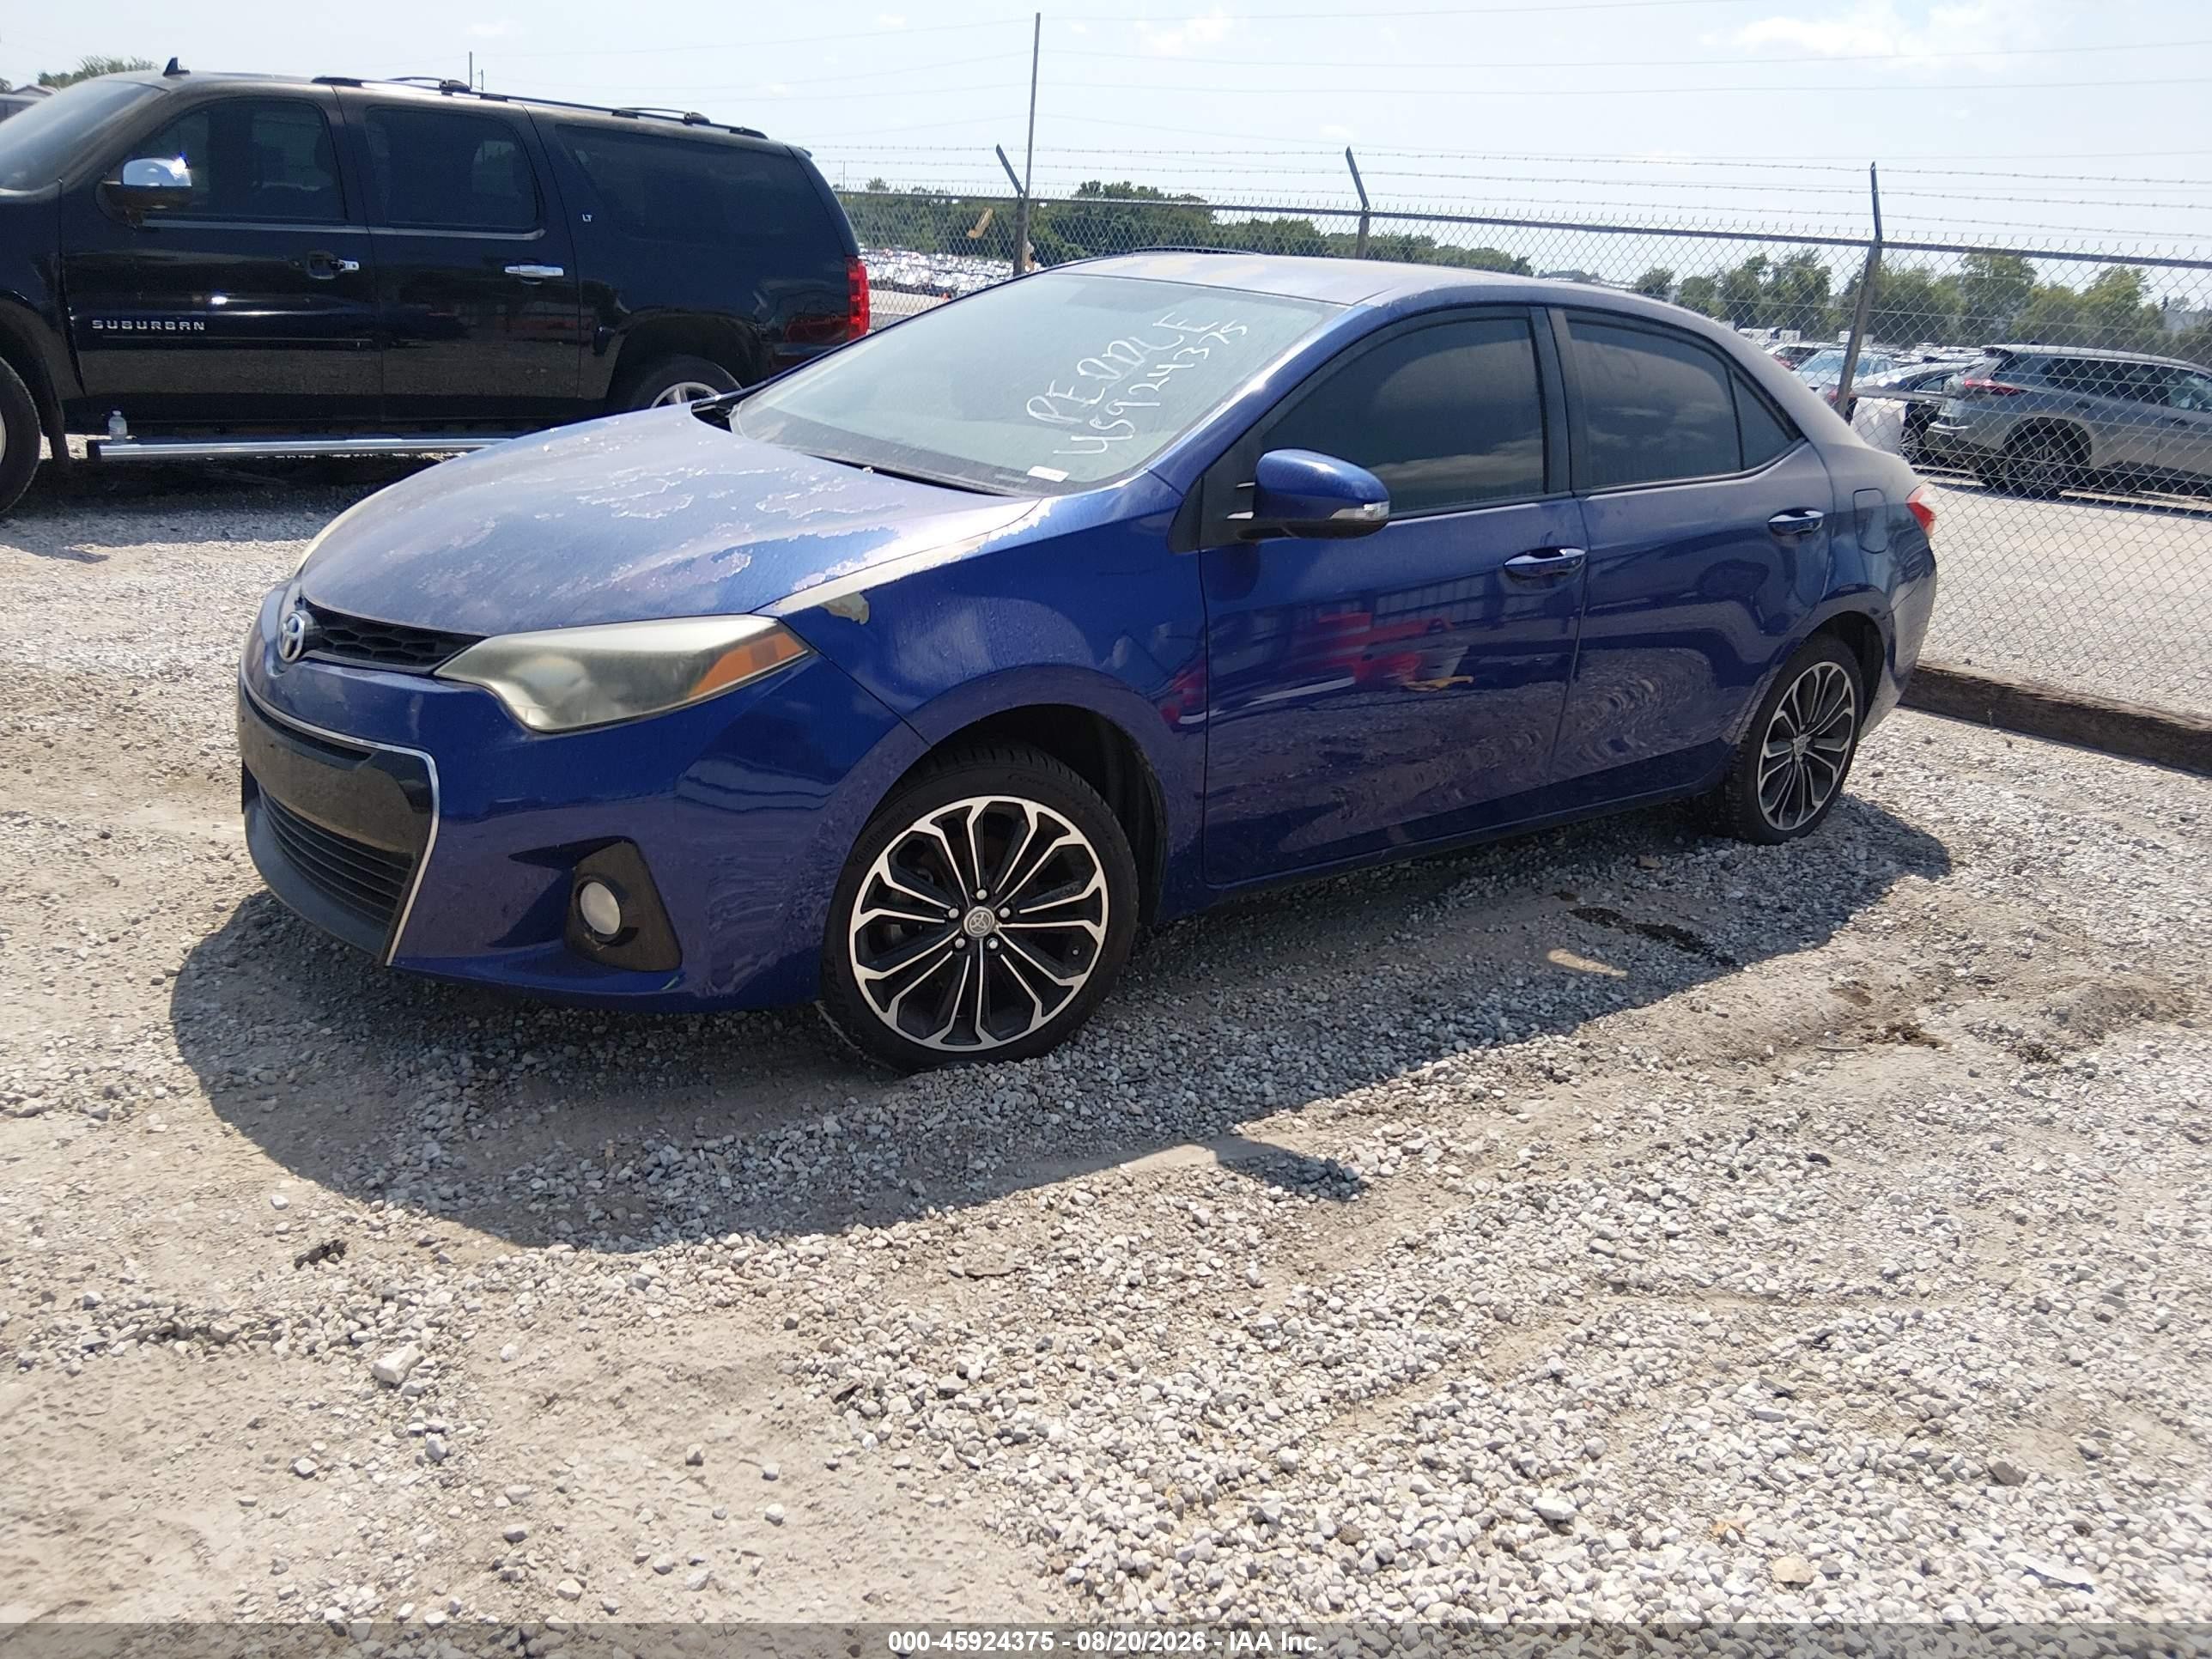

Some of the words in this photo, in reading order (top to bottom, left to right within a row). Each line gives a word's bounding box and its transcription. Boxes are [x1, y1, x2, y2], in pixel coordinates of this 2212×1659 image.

[582, 214, 592, 222] LT
[91, 319, 205, 331] SUBURBAN
[1053, 319, 1247, 454] 45924375
